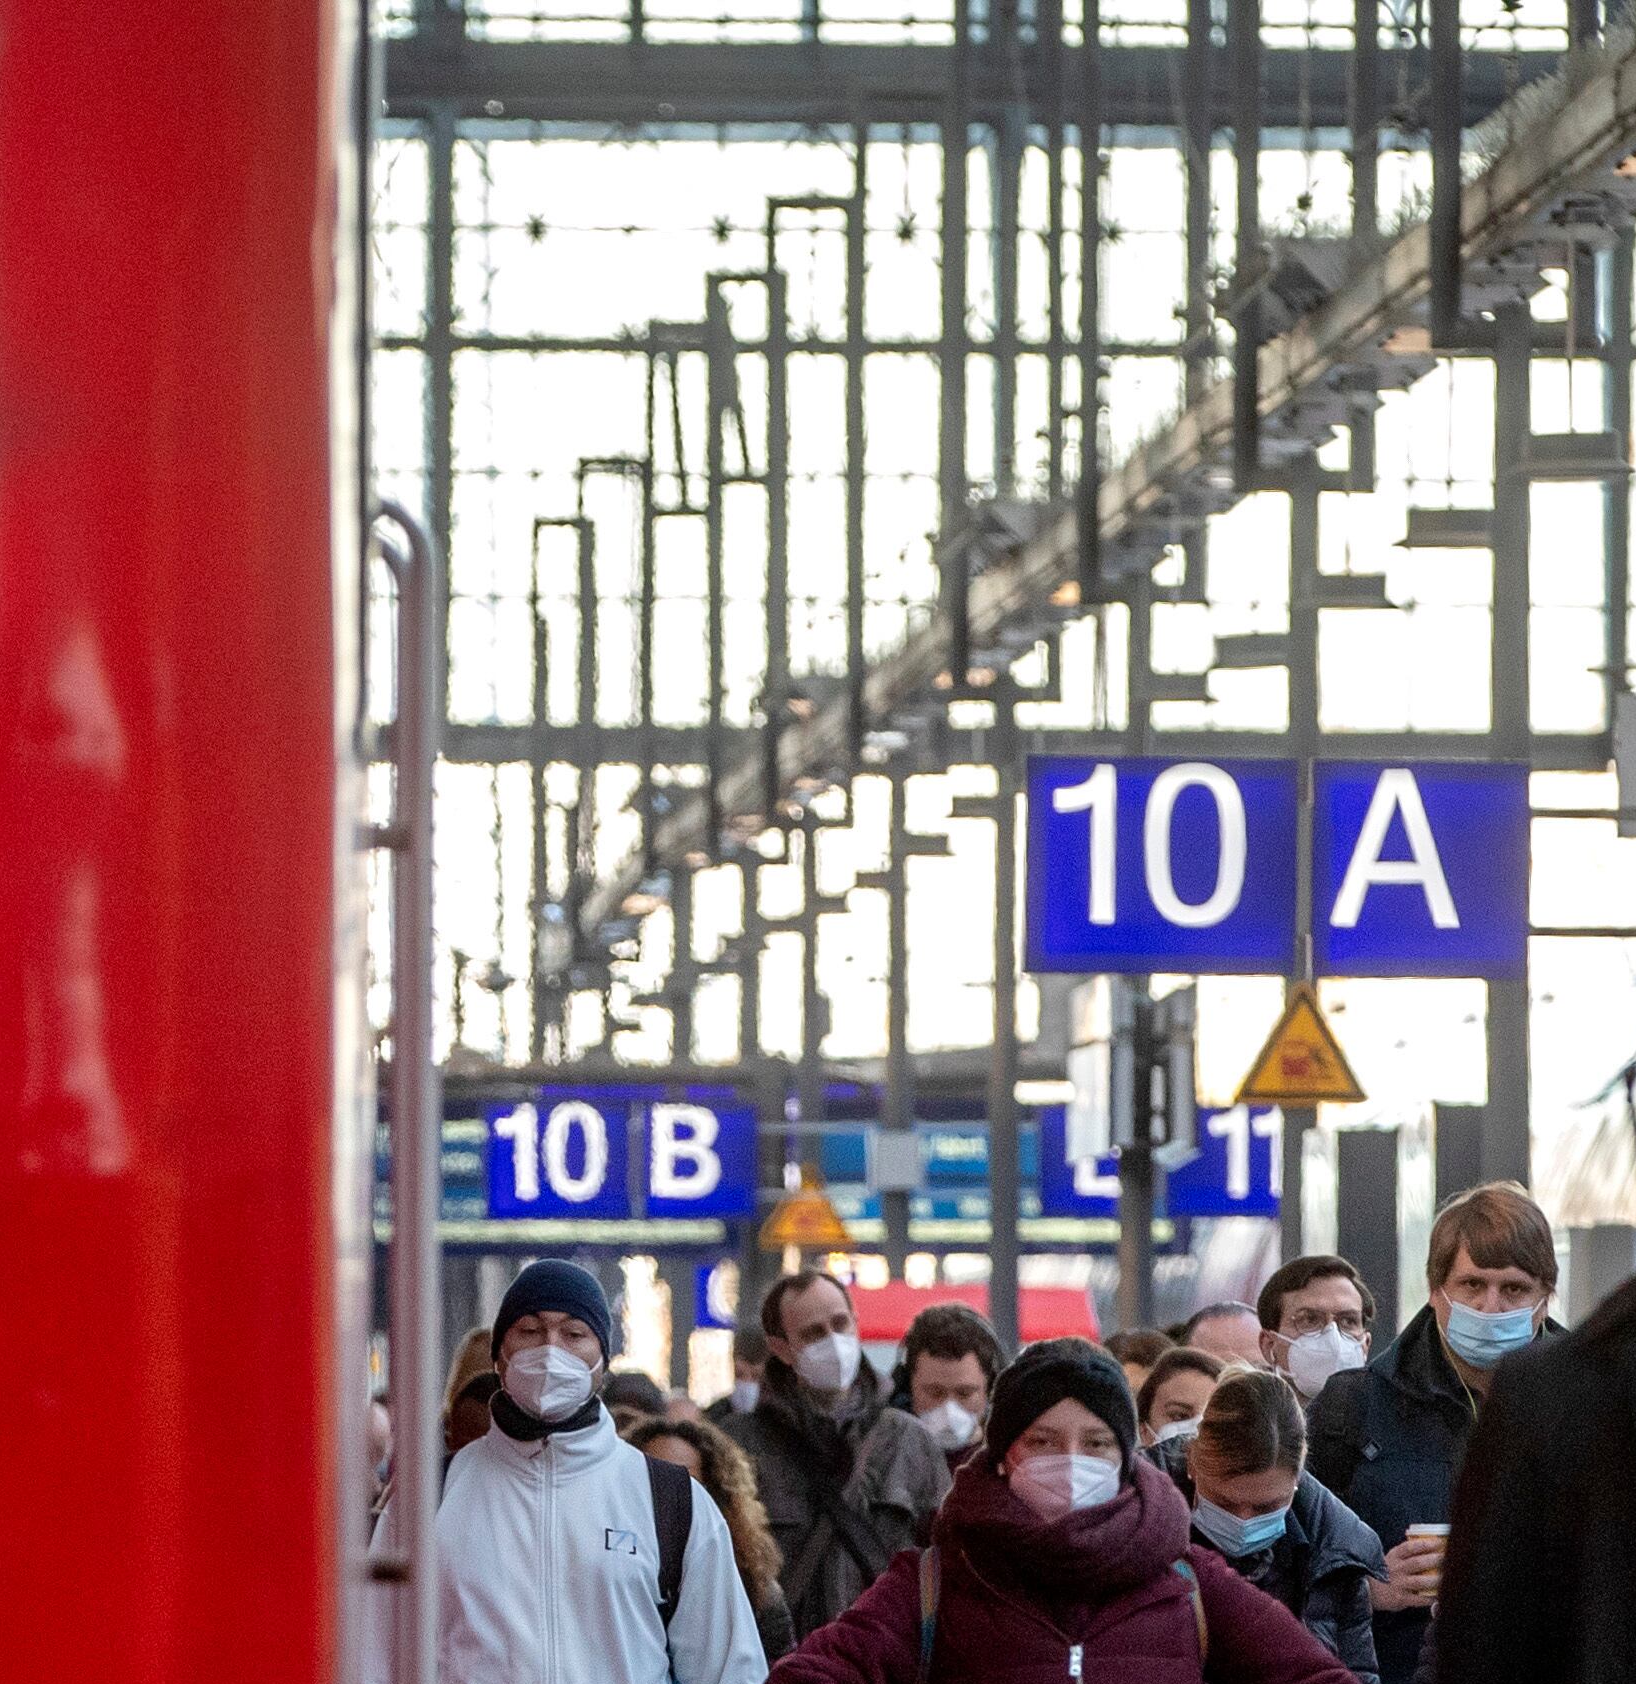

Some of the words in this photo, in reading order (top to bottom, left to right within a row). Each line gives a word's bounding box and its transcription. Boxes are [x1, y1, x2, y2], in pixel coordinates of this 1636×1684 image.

[1052, 761, 1247, 928] 10
[1330, 768, 1461, 928] A
[495, 1102, 607, 1201] 10
[650, 1102, 722, 1199] B
